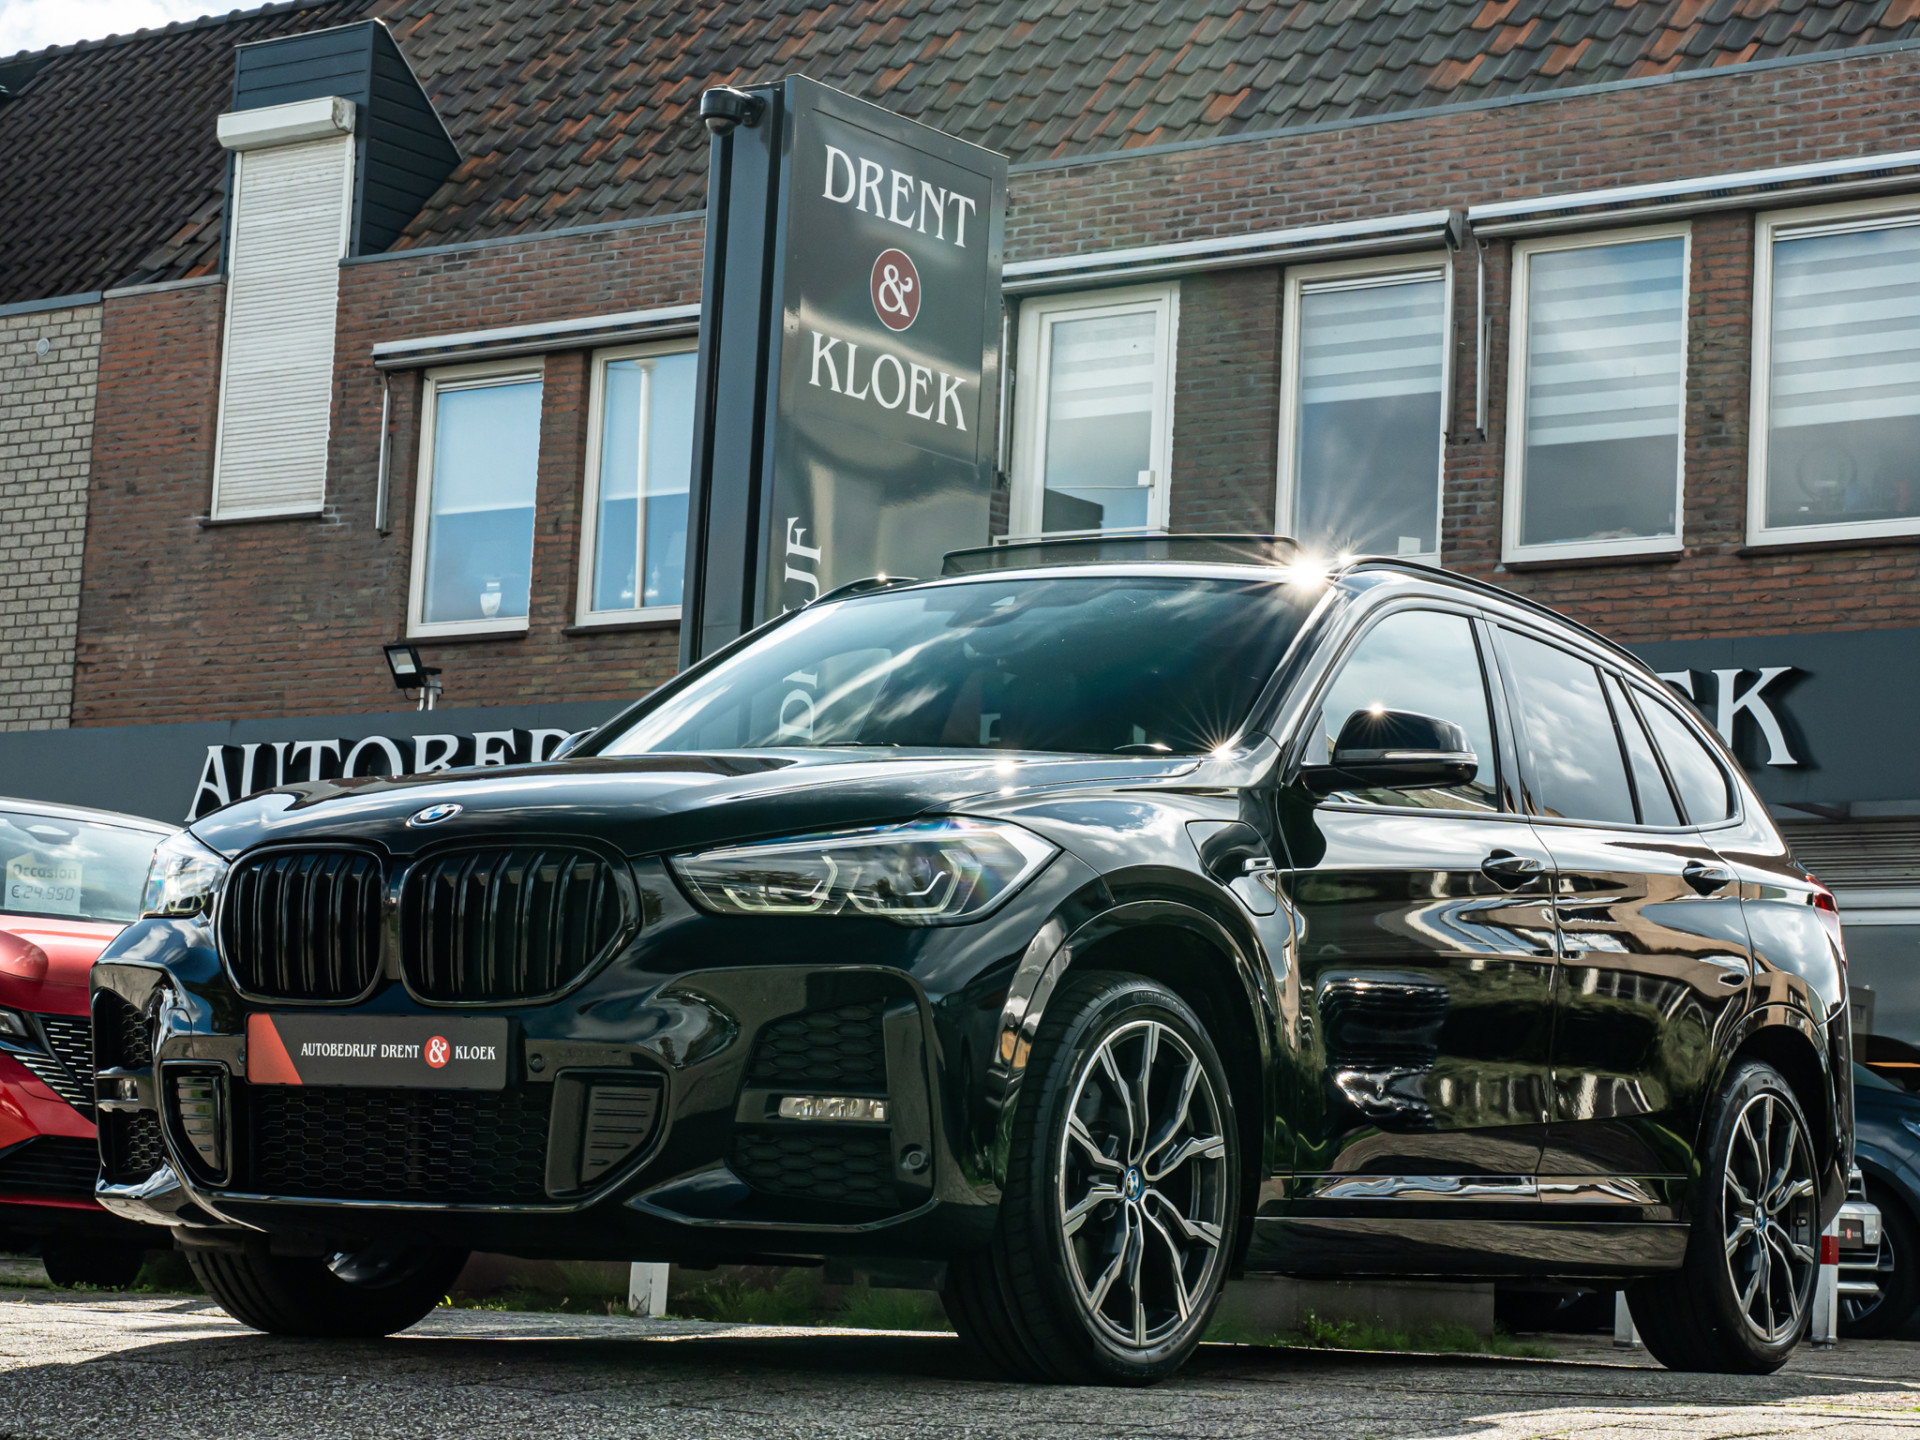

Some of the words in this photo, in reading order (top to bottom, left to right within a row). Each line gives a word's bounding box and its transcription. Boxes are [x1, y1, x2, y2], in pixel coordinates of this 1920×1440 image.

[821, 144, 977, 248] DRENT
[877, 263, 913, 318] &
[808, 330, 968, 432] KLOEK
[13, 864, 77, 880] Occasion
[301, 1042, 378, 1058] AUTOBEDRIJF
[381, 1044, 420, 1059] DRENT
[429, 1039, 447, 1063] &
[455, 1045, 496, 1060] KLOEK
